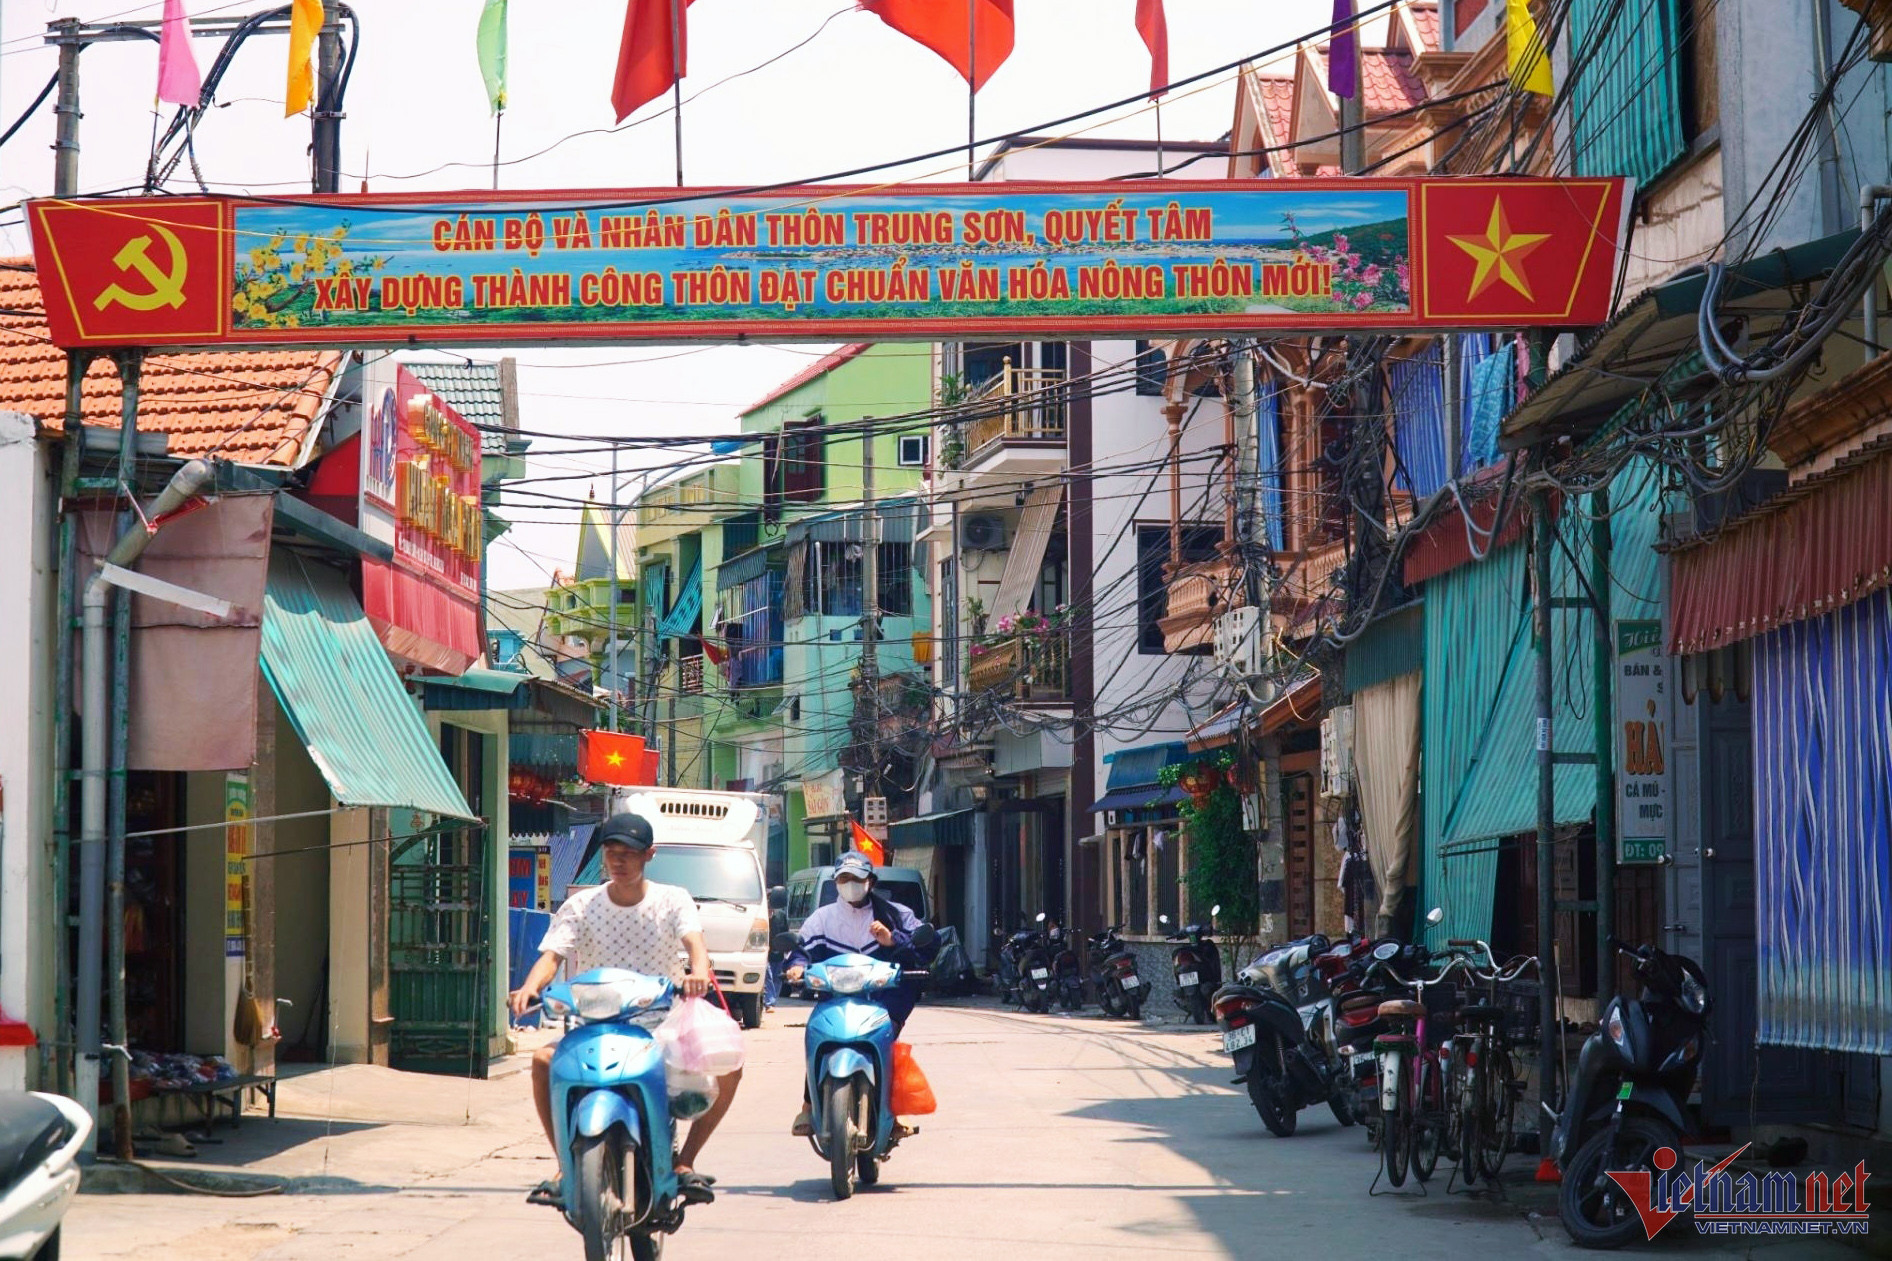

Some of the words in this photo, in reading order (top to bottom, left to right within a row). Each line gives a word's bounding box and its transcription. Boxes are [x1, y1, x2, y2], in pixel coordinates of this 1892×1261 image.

[432, 213, 495, 252] CÁN
[503, 212, 544, 259] BỘ
[553, 210, 592, 250] VÀ
[600, 208, 685, 248] NHÂN
[694, 207, 756, 248] DÂN
[765, 206, 844, 246] THÔN
[853, 211, 953, 245] TRUNG
[962, 208, 1035, 246] SƠN,
[1044, 199, 1138, 246] QUYẾT
[1146, 201, 1212, 242] TÂM
[314, 271, 372, 311] XÂY
[381, 273, 463, 316] DỰNG
[472, 268, 570, 308] THÀNH
[580, 266, 663, 306] CÔNG
[671, 265, 750, 305] THÔN
[759, 269, 817, 311] ĐẠT
[825, 256, 929, 302] CHUẨN
[938, 259, 999, 300] VĂN
[1008, 259, 1070, 300] HÓA
[1078, 258, 1164, 299] NÔNG
[1172, 256, 1252, 298] THÔN
[1261, 255, 1332, 297] MỚI!
[1624, 662, 1650, 677] BÁN
[1626, 781, 1639, 798] CÁ
[1639, 803, 1663, 822] MỰC
